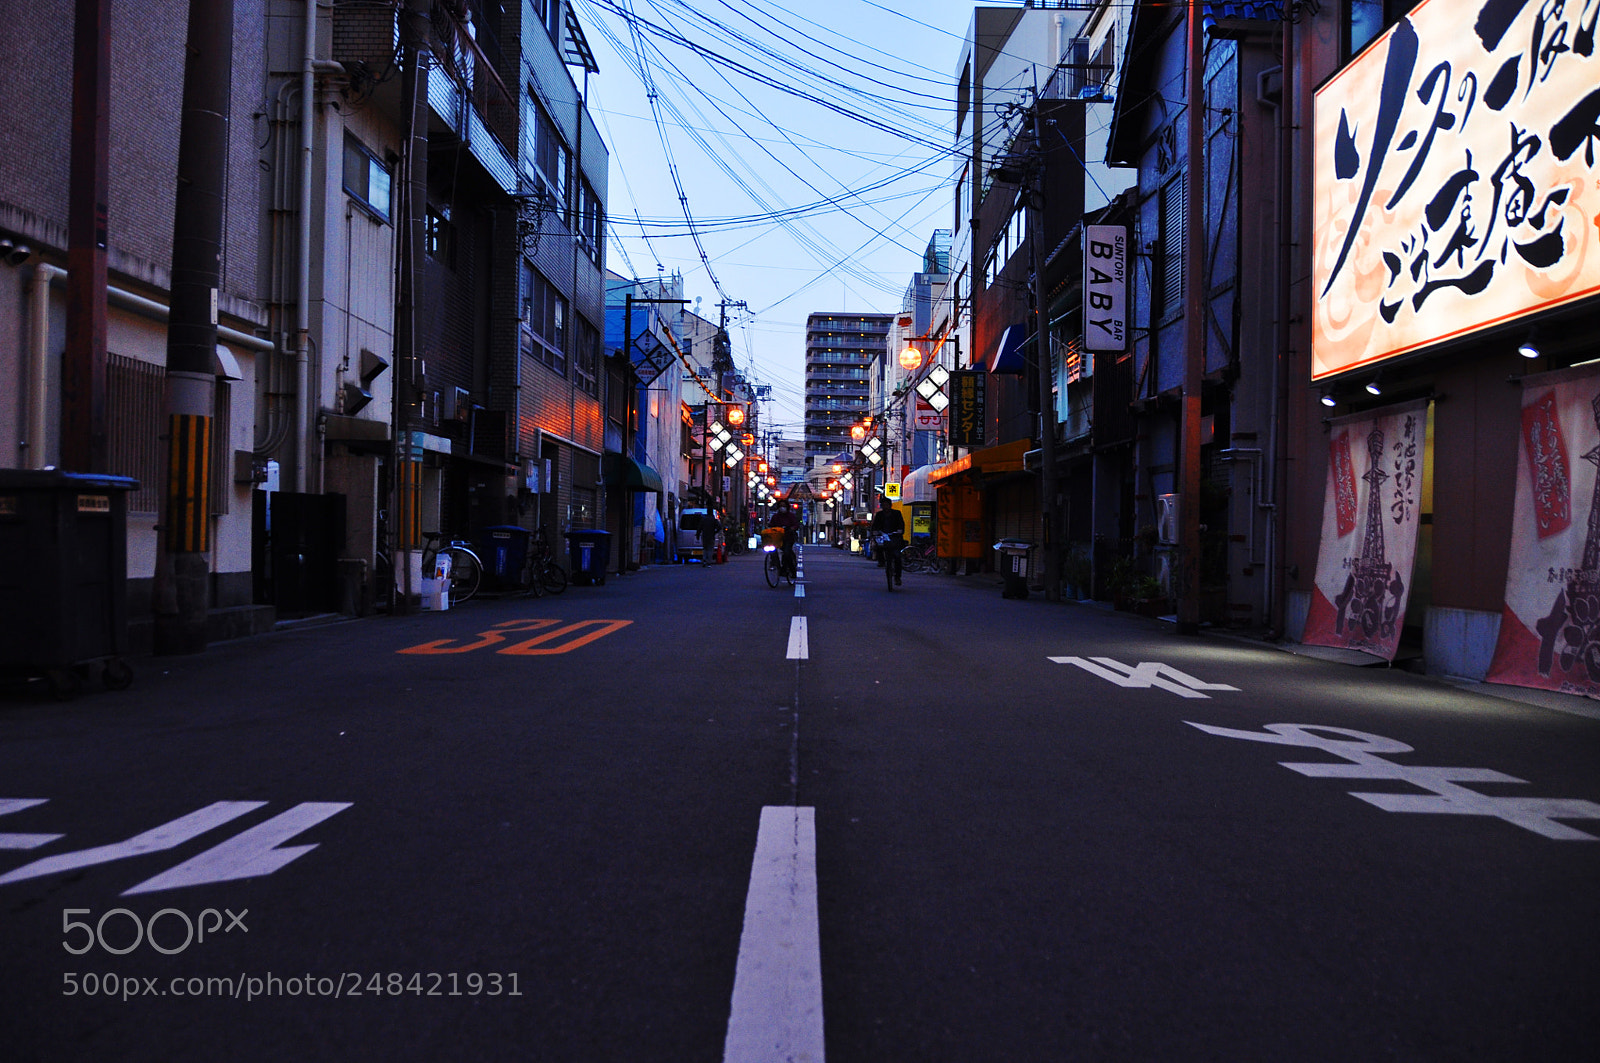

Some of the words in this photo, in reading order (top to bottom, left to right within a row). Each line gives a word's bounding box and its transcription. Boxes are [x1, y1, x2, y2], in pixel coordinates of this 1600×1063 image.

[1115, 235, 1124, 283] SUNTORY
[1089, 240, 1113, 335] BABY
[1114, 320, 1123, 341] BAR
[396, 618, 634, 656] 30
